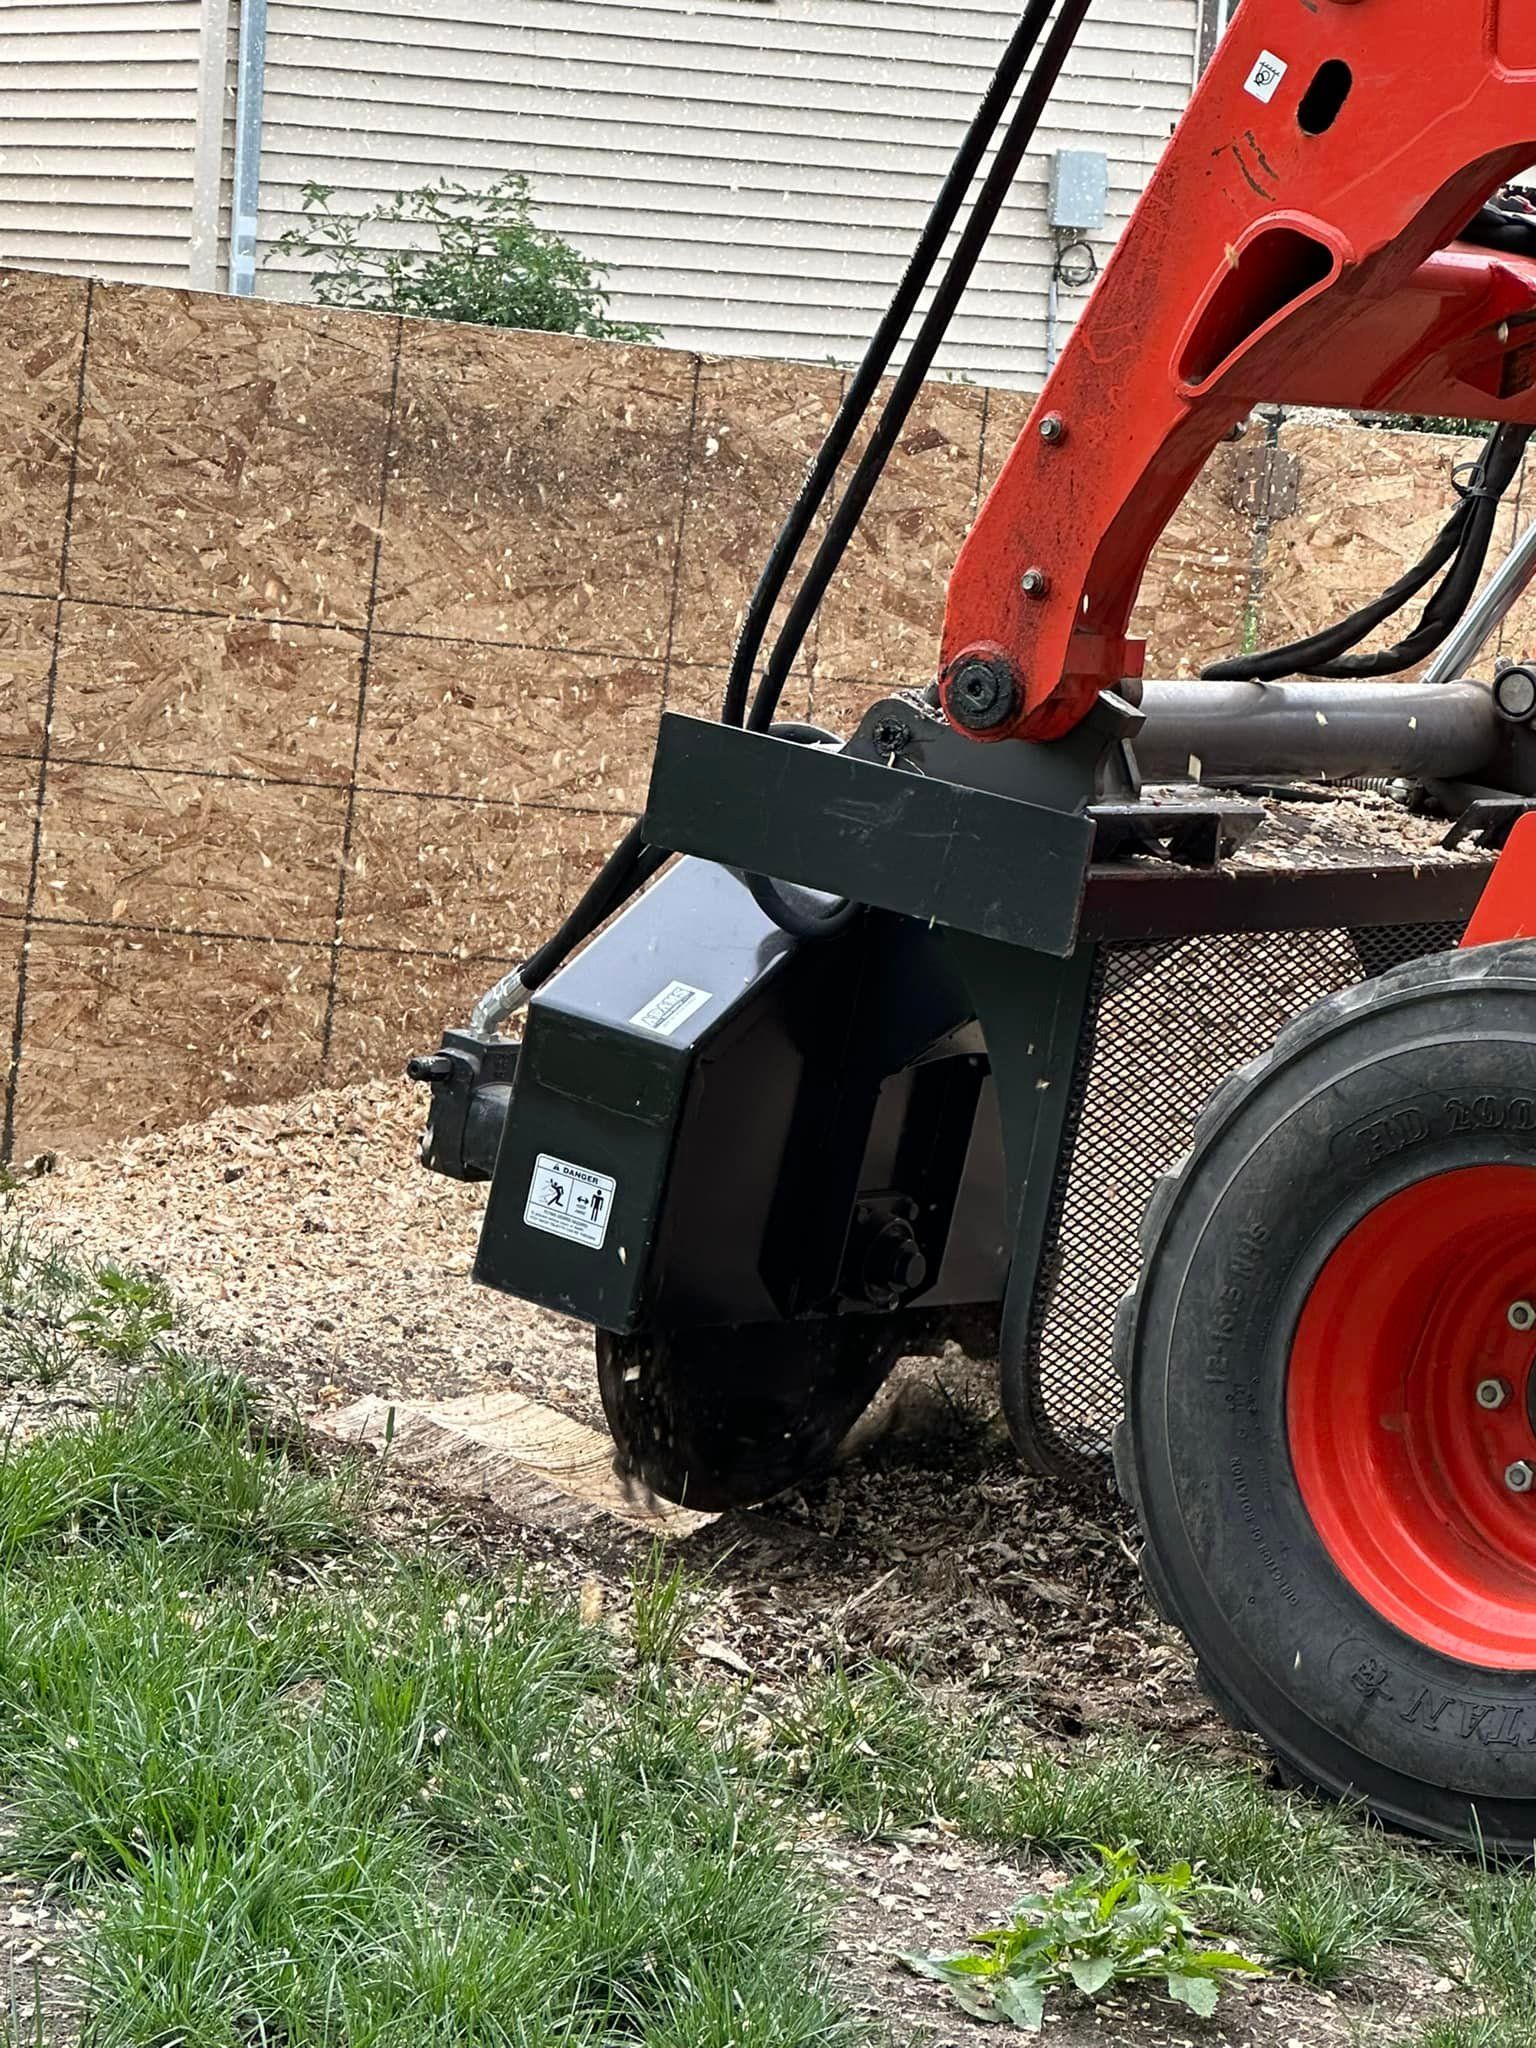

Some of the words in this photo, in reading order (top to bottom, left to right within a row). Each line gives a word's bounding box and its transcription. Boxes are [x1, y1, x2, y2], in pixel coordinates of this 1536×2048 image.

[1353, 1107, 1428, 1165] HD
[562, 1167, 599, 1185] DANGER
[1229, 1454, 1256, 1522] ROTATION
